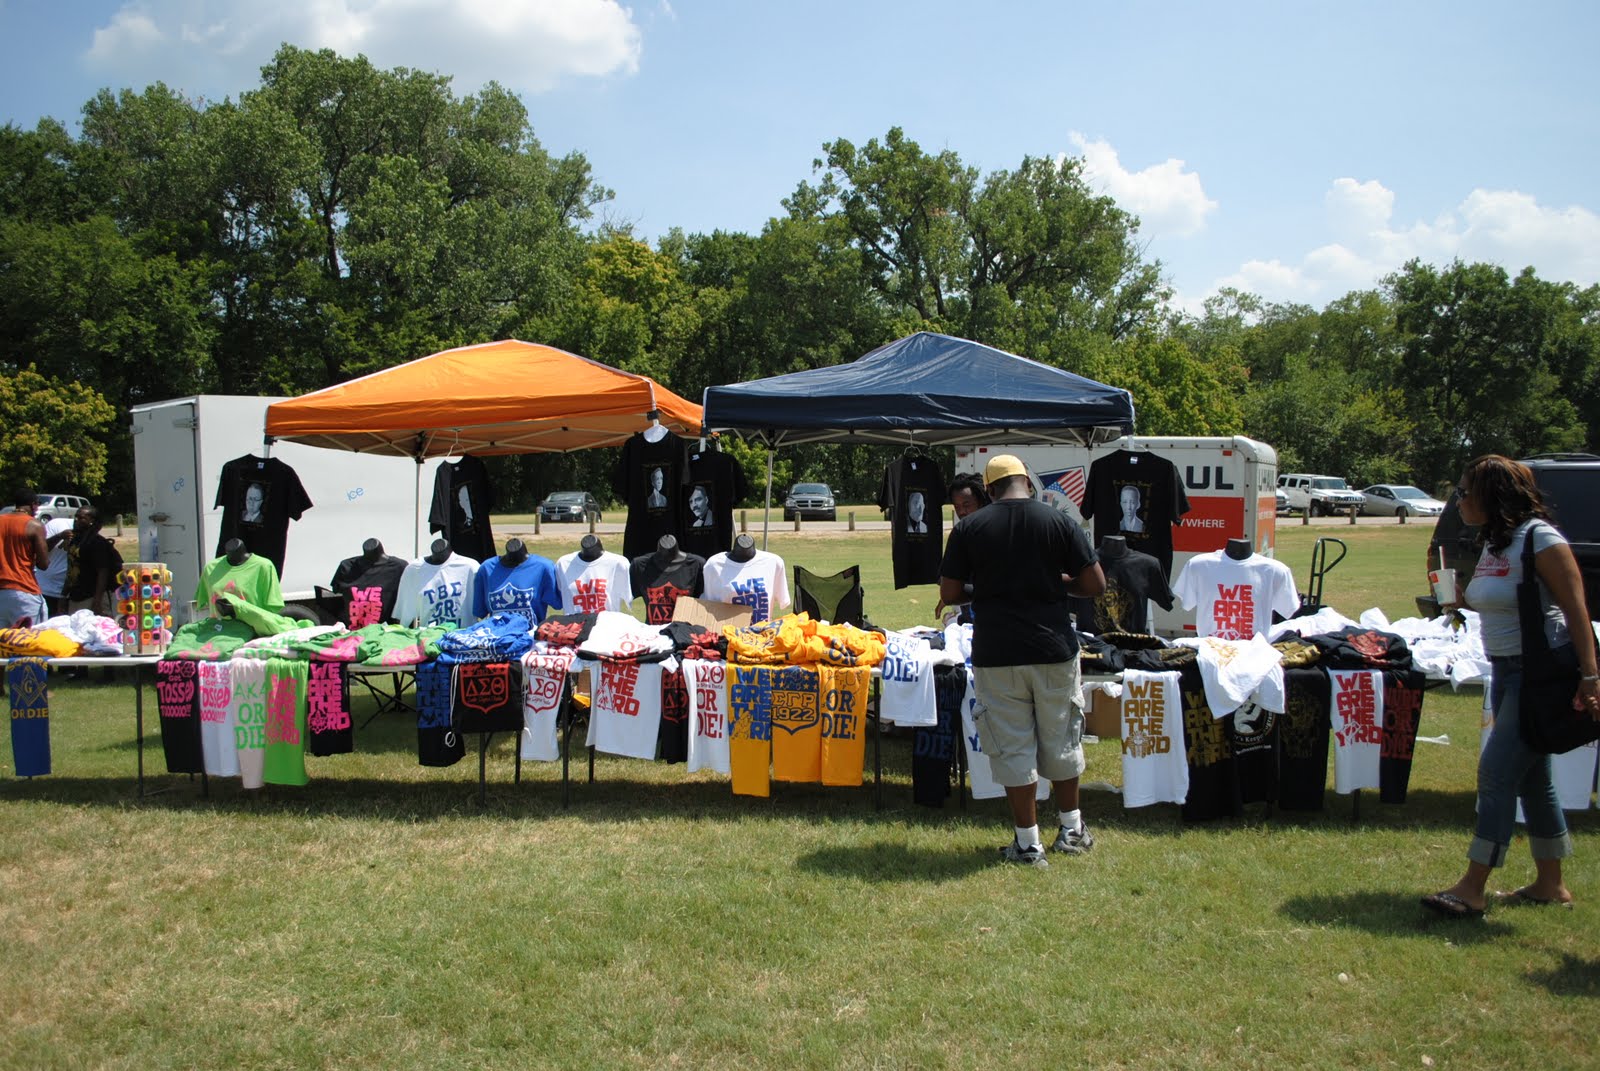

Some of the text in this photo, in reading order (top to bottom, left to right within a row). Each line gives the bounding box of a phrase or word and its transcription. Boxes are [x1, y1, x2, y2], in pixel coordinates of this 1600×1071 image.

[351, 586, 382, 601] WE
[575, 578, 607, 594] WE
[731, 577, 765, 596] WE
[1216, 583, 1252, 600] WE
[349, 601, 383, 617] ARE
[652, 605, 673, 621] ΔΣ
[1213, 600, 1254, 618] ARE
[1213, 617, 1254, 635] THE
[310, 662, 341, 680] WE
[735, 667, 772, 685] WE
[881, 656, 919, 682] DIE!
[24, 680, 33, 694] G
[308, 679, 342, 697] ARE
[465, 677, 506, 697] ΔΣΘ
[601, 672, 636, 698] THE
[1126, 680, 1165, 699] WE
[1335, 671, 1373, 691] WE
[730, 684, 772, 703] ARE
[825, 688, 854, 712] OR
[1335, 688, 1375, 711] ARE
[308, 695, 342, 713] THE
[730, 702, 772, 723] THE
[1124, 698, 1165, 718] ARE
[11, 708, 25, 720] OR
[238, 703, 267, 725] OR
[771, 706, 815, 722] 1922
[1338, 706, 1375, 727] THE
[821, 712, 858, 741] DIE!
[1124, 717, 1164, 737] THE
[1186, 724, 1225, 747] THE
[233, 725, 266, 750] DIE
